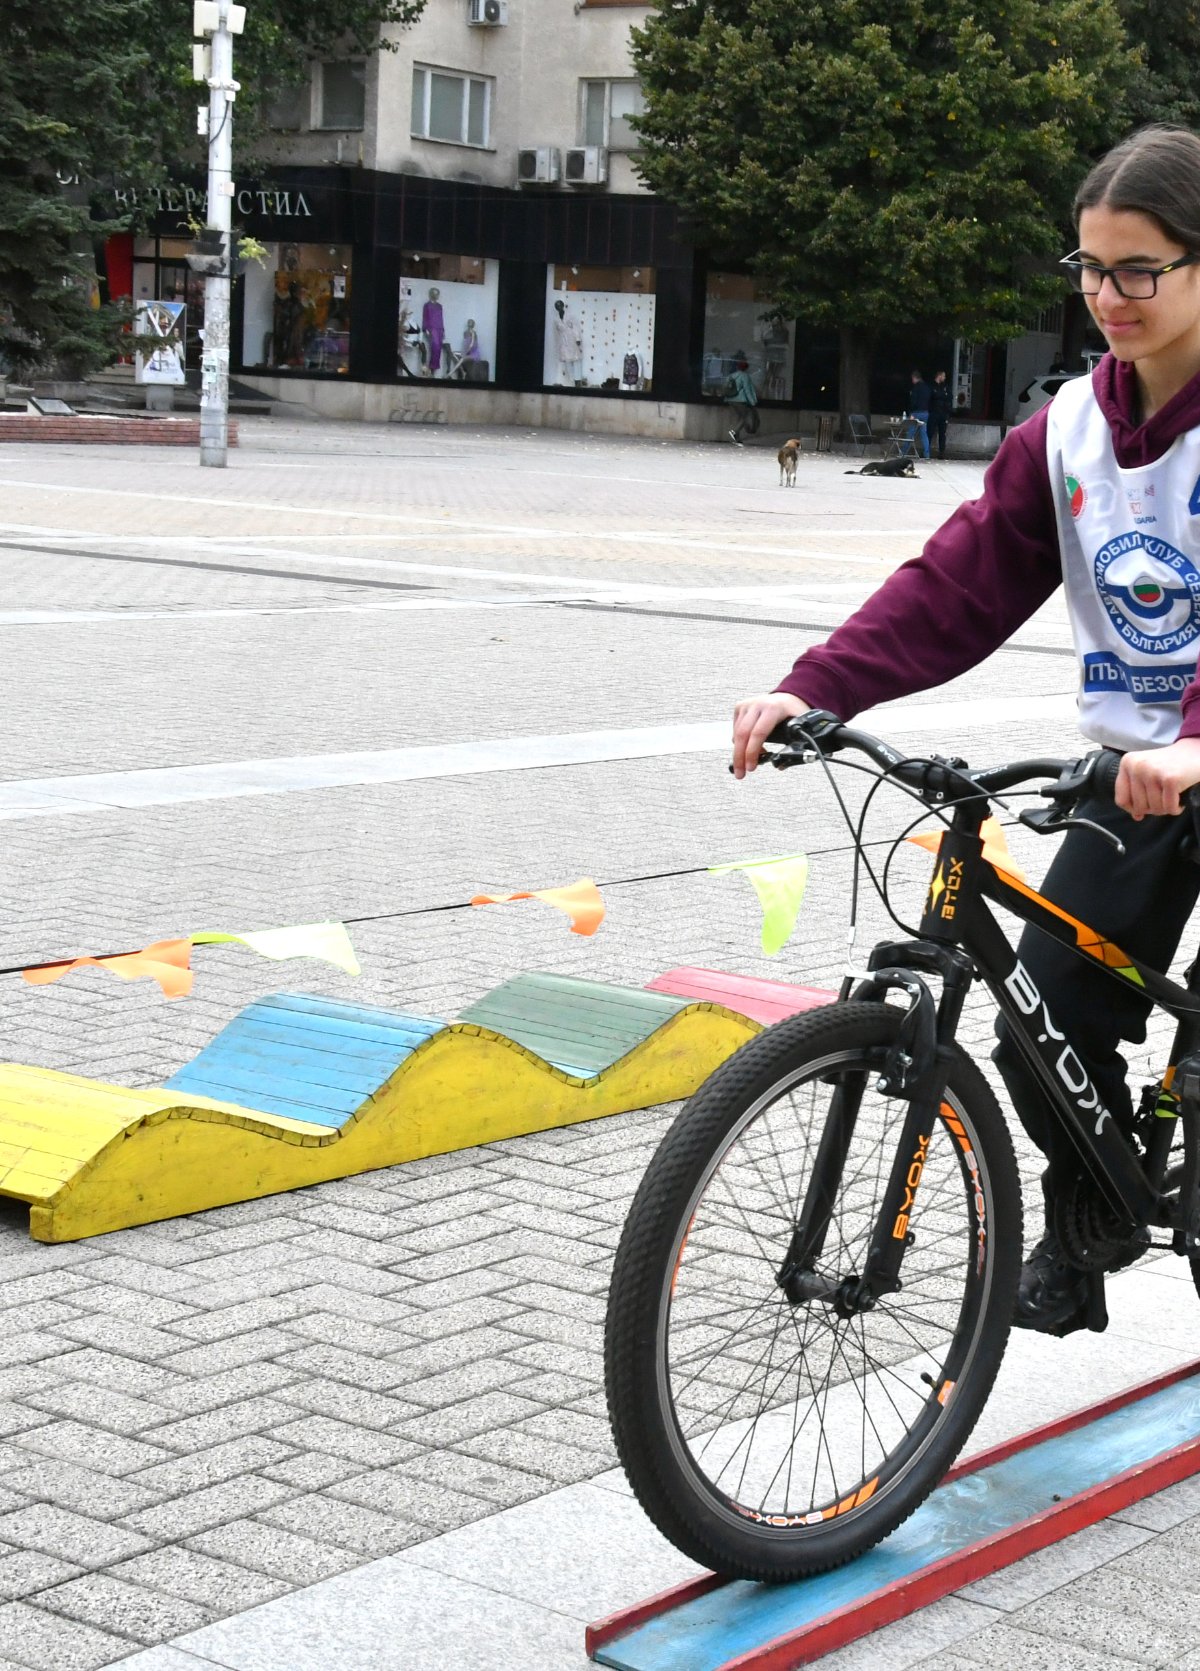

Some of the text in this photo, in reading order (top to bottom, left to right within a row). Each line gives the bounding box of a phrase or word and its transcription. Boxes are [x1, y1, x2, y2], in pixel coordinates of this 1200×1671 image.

[238, 190, 312, 216] СТИЛ
[1144, 538, 1186, 568] КЛУБ
[1121, 623, 1199, 652] БЪЛГАРИЯ
[877, 745, 898, 764] BYO
[971, 764, 1008, 780] BYOX
[941, 857, 964, 919] BYOX
[1004, 959, 1112, 1135] BYOX
[893, 1135, 931, 1240] BYOX
[964, 1151, 986, 1235] BYOX
[756, 1511, 824, 1527] BYOX
